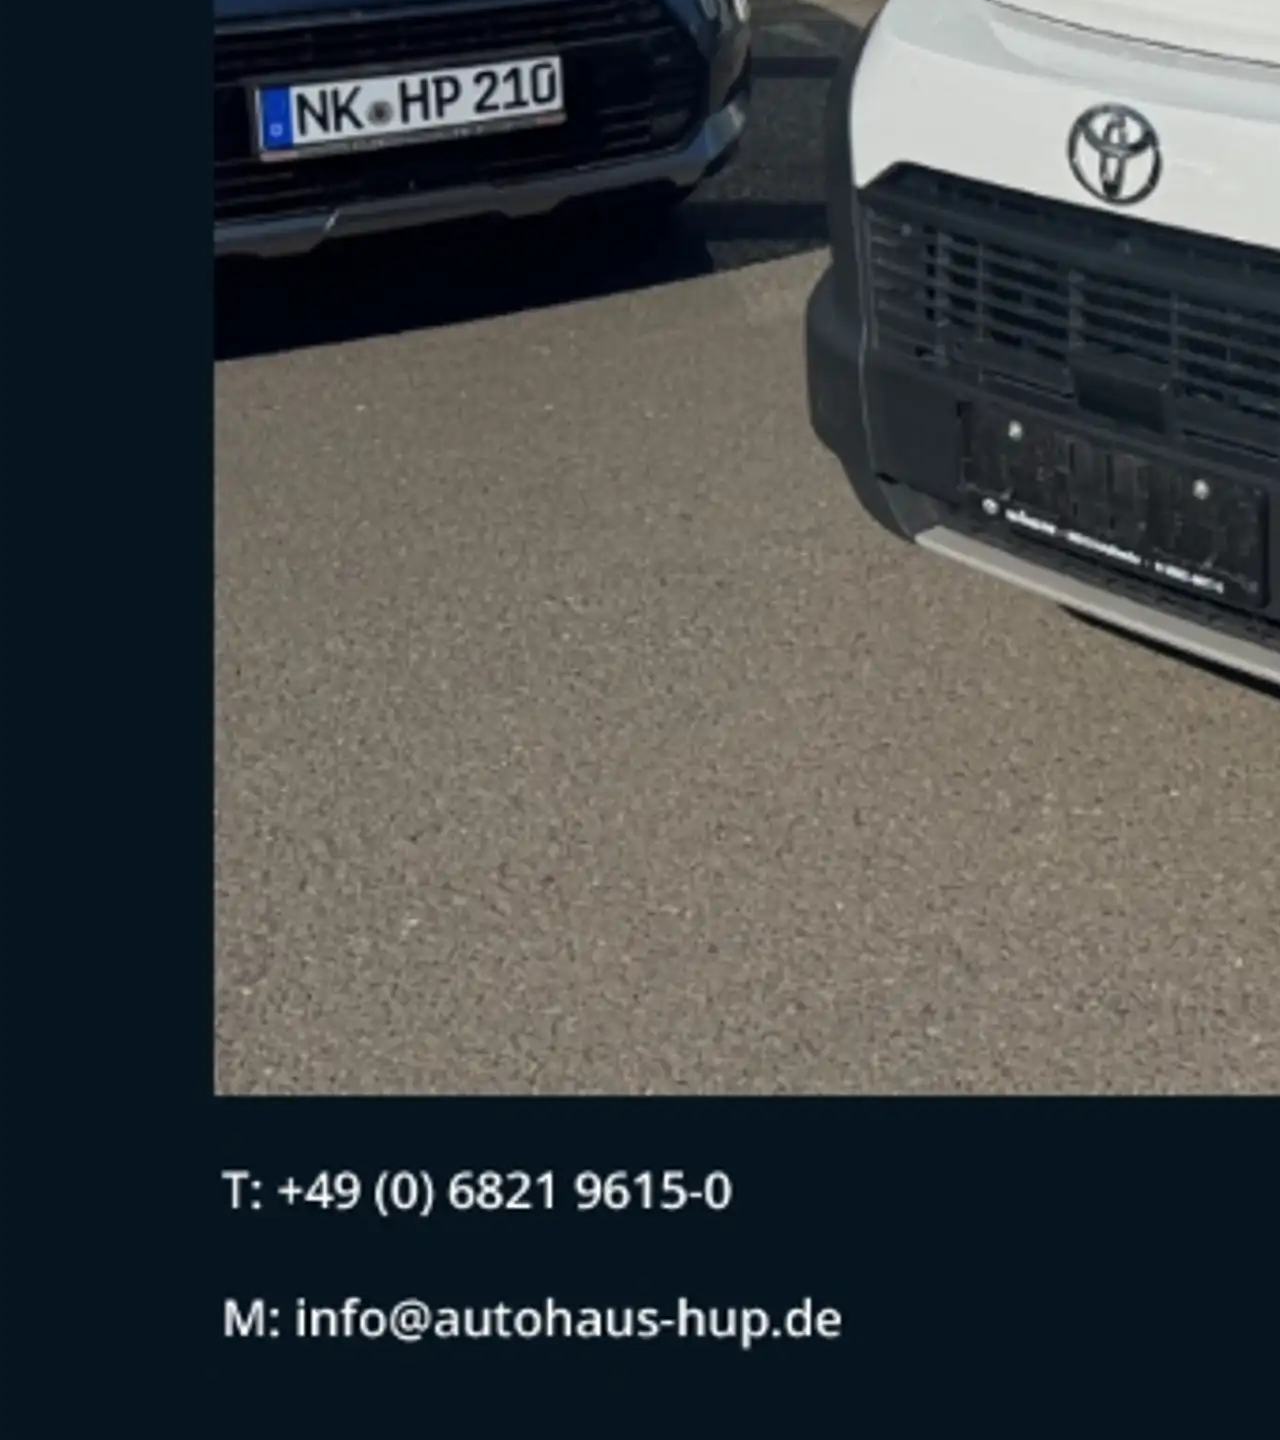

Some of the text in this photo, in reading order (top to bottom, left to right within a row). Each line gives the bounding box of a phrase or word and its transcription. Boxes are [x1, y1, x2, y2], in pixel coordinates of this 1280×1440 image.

[296, 63, 557, 136] NK HP 210
